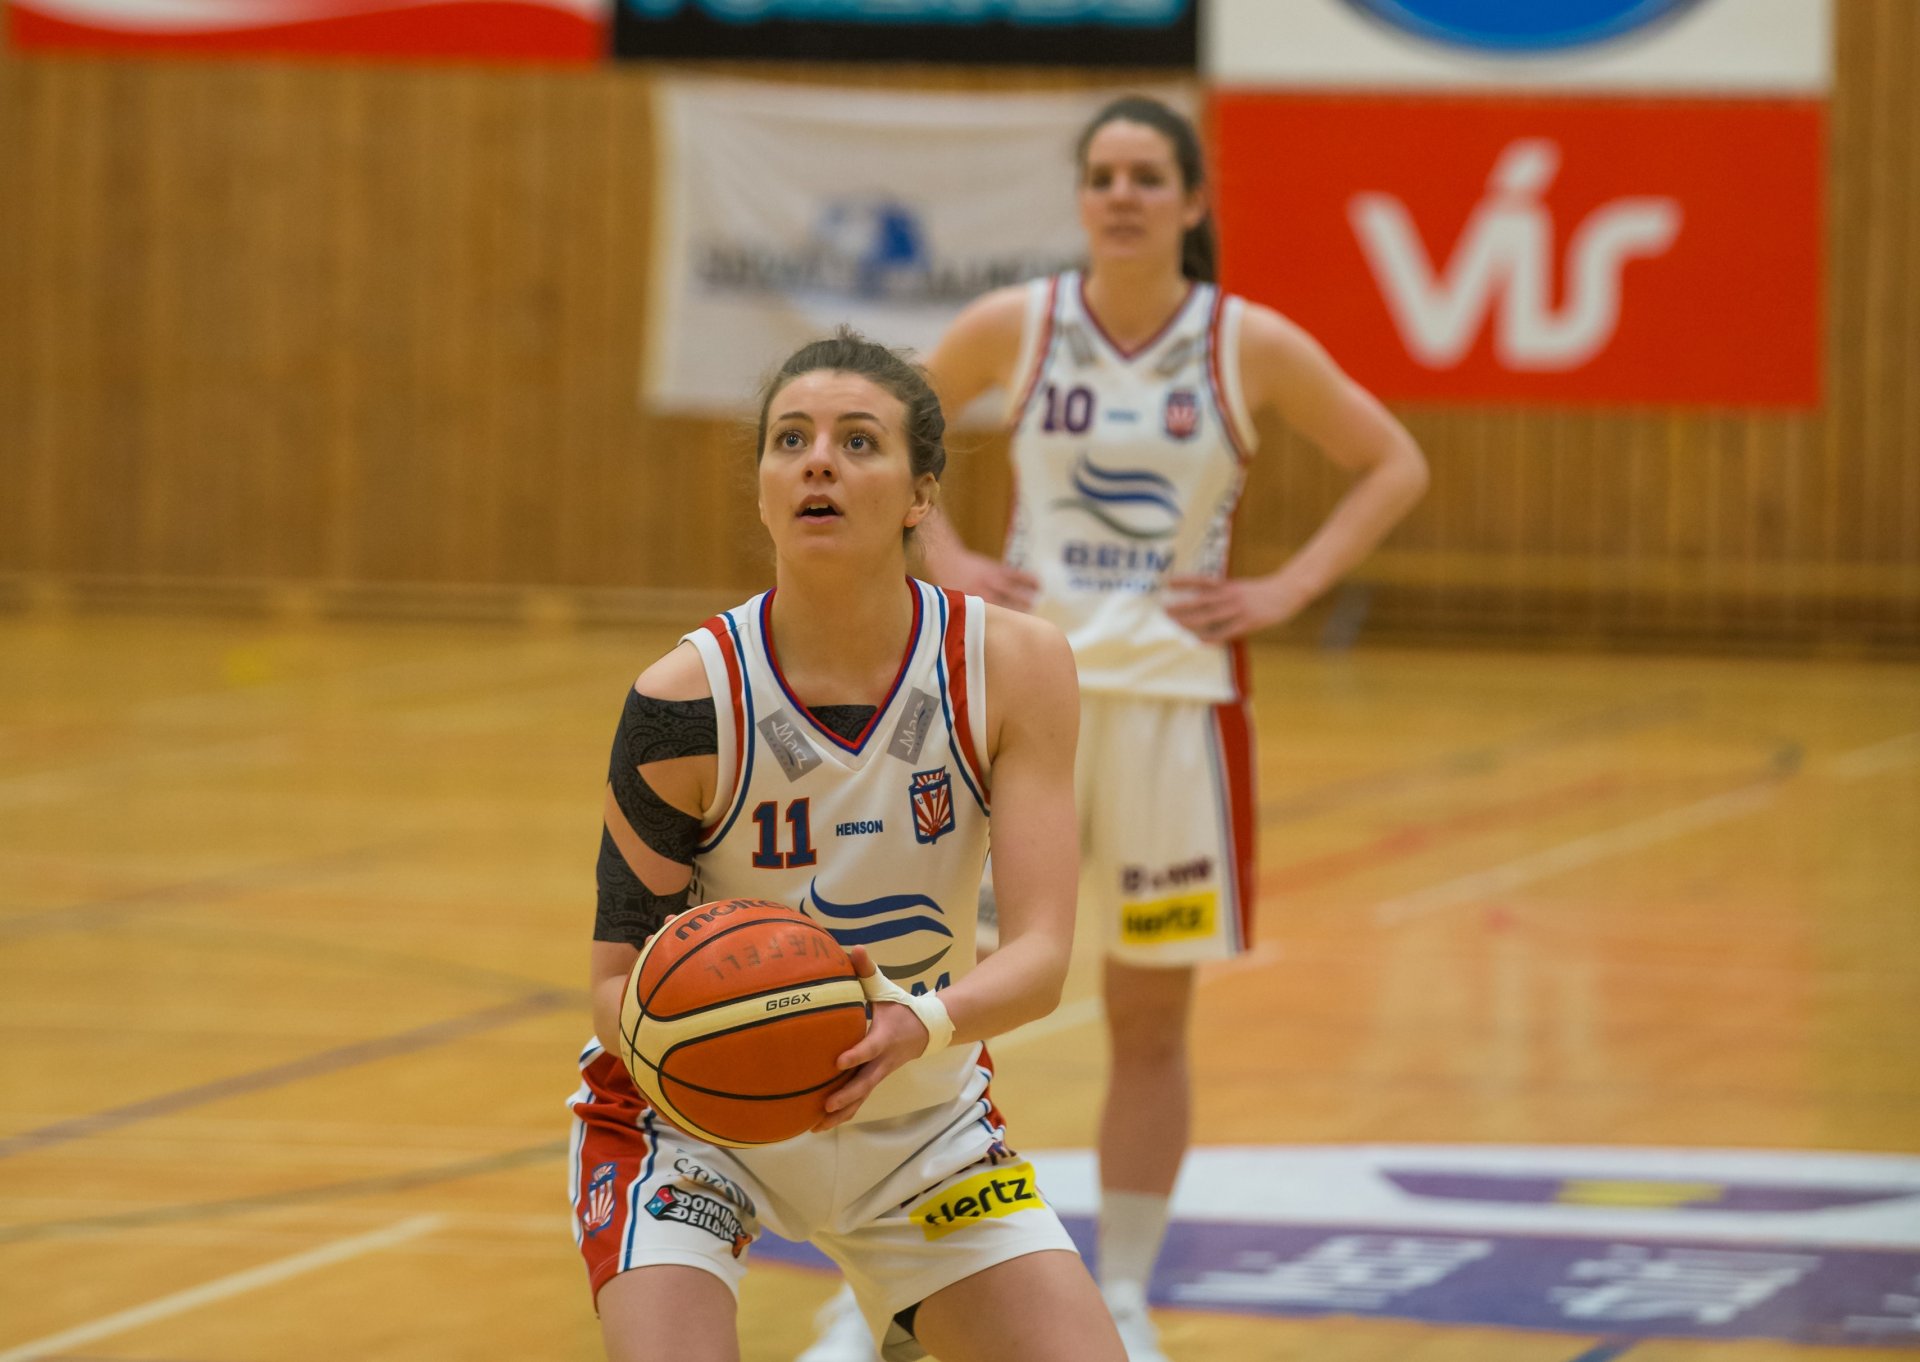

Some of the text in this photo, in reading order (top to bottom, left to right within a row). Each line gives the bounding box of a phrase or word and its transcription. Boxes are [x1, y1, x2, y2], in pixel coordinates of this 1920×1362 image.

[1042, 384, 1094, 433] 10
[752, 797, 817, 869] 11
[836, 819, 883, 837] HENSON
[675, 899, 793, 940] molte
[766, 992, 811, 1011] GG6X
